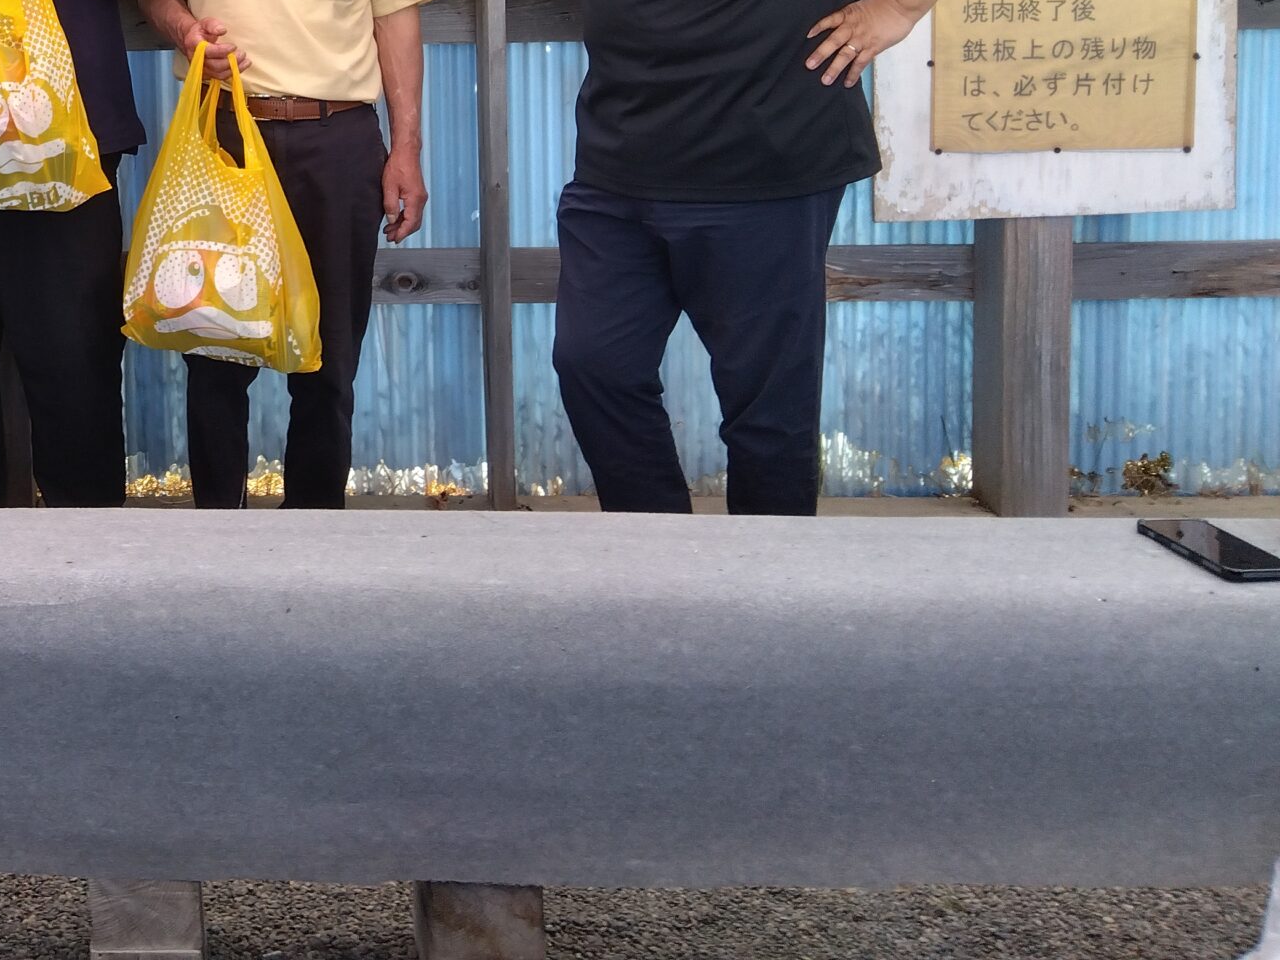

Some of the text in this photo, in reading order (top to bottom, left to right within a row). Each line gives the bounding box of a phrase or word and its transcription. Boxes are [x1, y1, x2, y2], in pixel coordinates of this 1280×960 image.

[962, 36, 1157, 62] 鉄板上の残り物
[962, 73, 1155, 97] は、必ず片付け
[961, 109, 1081, 132] てください。
